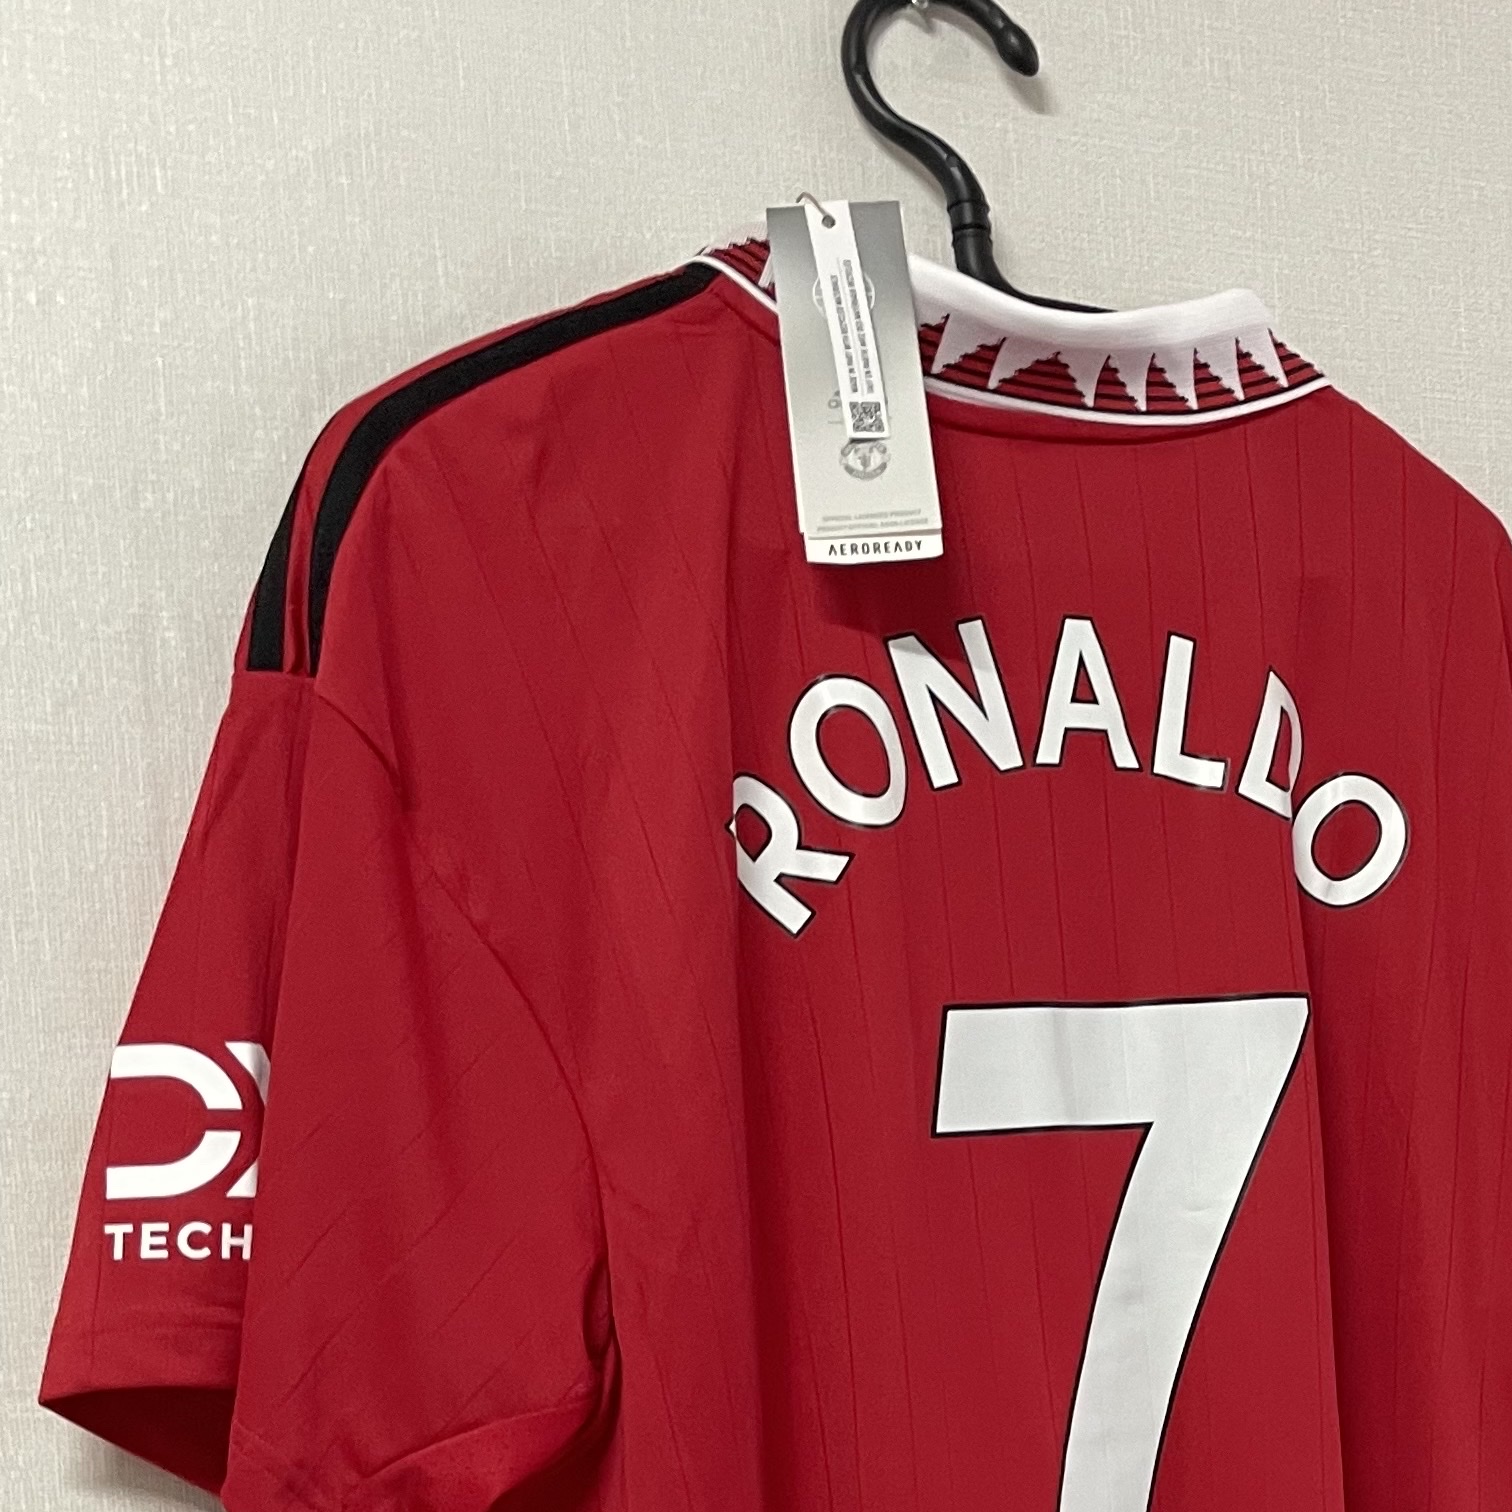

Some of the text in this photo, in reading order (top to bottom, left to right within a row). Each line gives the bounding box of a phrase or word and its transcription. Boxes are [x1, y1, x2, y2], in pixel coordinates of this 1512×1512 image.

[828, 539, 923, 557] AEROREADY
[725, 614, 1408, 938] RONALDO
[104, 1221, 253, 1260] TECH
